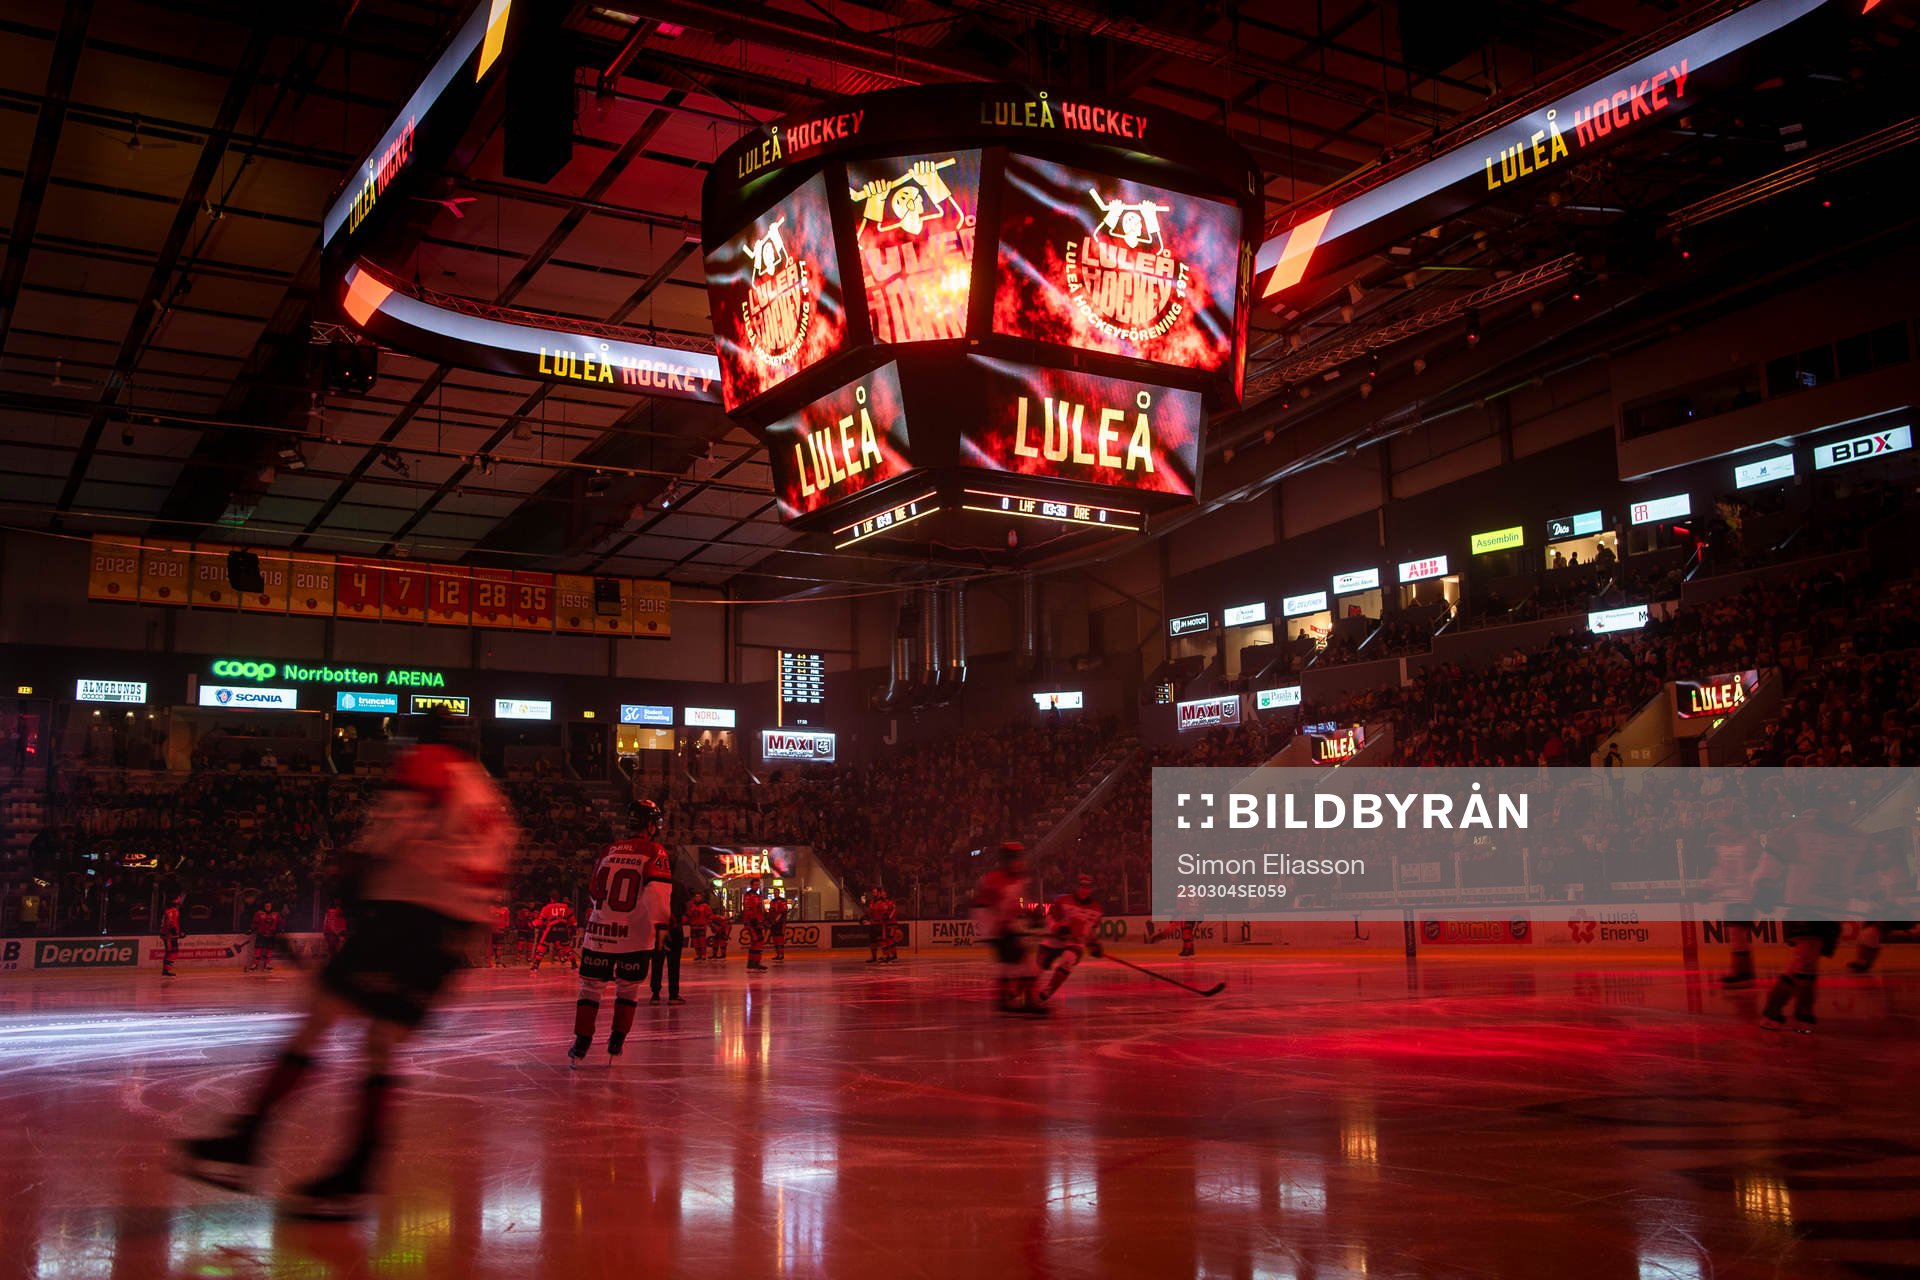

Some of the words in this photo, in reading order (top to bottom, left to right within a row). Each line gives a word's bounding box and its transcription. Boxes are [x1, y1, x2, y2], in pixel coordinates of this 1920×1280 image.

[981, 91, 1055, 128] LULEÅ
[1061, 102, 1147, 139] HOCKEY
[1485, 109, 1568, 191] LULEÅ
[1574, 59, 1689, 147] HOCKEY
[738, 126, 782, 179] LULEÅ
[786, 109, 864, 154] HOCKEY
[349, 158, 376, 235] LULEÅ
[377, 113, 415, 197] HOCKEY
[1082, 236, 1175, 278] LULEÅ
[748, 256, 799, 316] LULEÅ
[1082, 266, 1173, 324] HOCKEY
[1073, 294, 1183, 342] HOCKEYFÖRENING
[1176, 262, 1190, 298] 1977
[753, 285, 801, 350] HOCKEY
[539, 343, 614, 384] LULEÅ
[622, 356, 714, 393] HOCKEY
[795, 386, 883, 497] LULEÅ
[1014, 390, 1155, 473] LULEÅ
[1832, 433, 1893, 462] BDX
[1019, 500, 1036, 513] LHF
[1477, 533, 1520, 548] Assemblin
[96, 556, 135, 573] 2022
[149, 561, 183, 577] 2021
[200, 565, 228, 581] 201
[1409, 560, 1439, 578] ABB
[354, 572, 367, 597] 4
[399, 576, 411, 600] 7
[438, 578, 460, 604] 12
[479, 583, 506, 608] 28
[520, 586, 546, 610] 35
[213, 660, 276, 681] coop
[284, 664, 378, 684] Norrbotten
[386, 670, 445, 687] ARENA
[83, 682, 142, 694] ALMGRUNDS
[236, 693, 282, 702] SCANIA
[1691, 674, 1744, 712] LULEÅ
[1182, 702, 1220, 720] MAXI
[768, 735, 812, 750] MAXI
[1320, 730, 1356, 760] LULEÅ
[726, 849, 771, 874] LULEÅ
[1600, 928, 1649, 942] Energi
[42, 944, 132, 964] Derome
